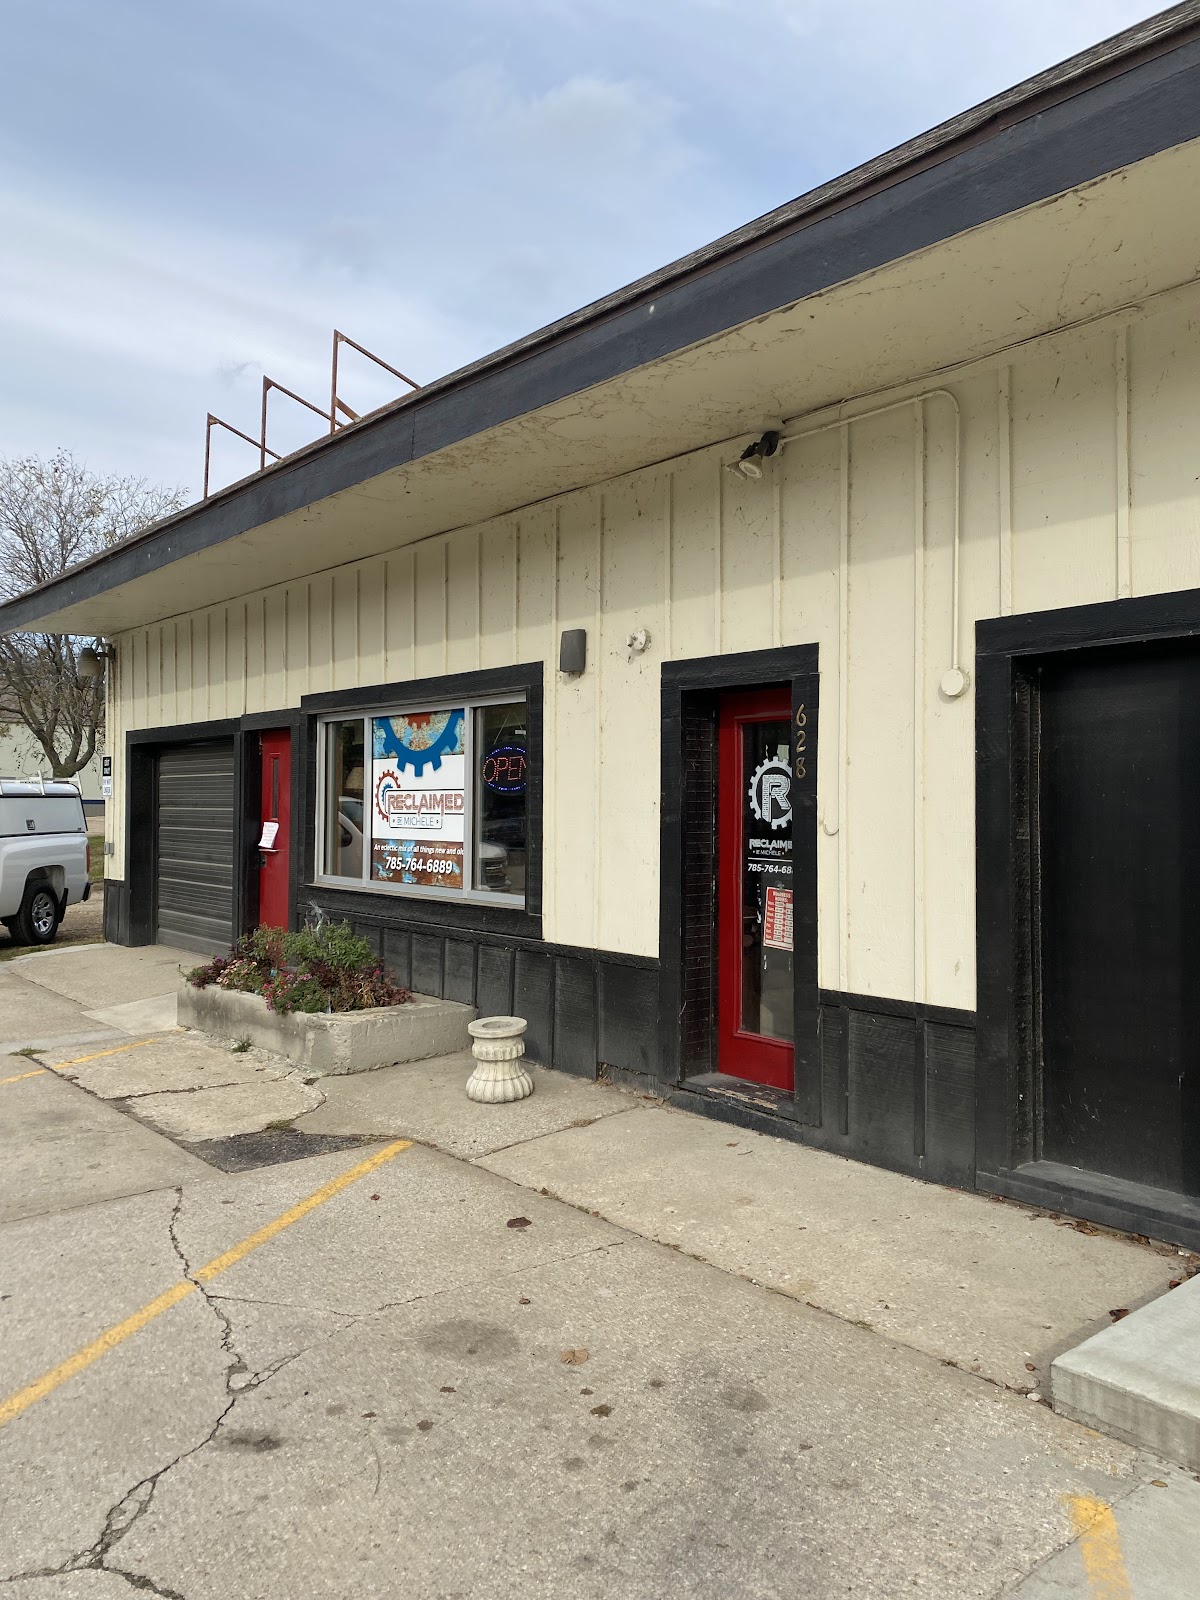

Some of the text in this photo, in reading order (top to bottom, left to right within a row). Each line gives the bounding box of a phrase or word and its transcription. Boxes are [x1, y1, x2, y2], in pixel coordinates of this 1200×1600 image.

[796, 703, 807, 779] 628
[388, 793, 464, 817] RECLAIMED
[762, 774, 791, 822] R
[404, 817, 434, 826] MICHELE
[373, 843, 381, 851] An
[381, 844, 398, 852] eclectic
[420, 845, 435, 855] things
[446, 847, 456, 855] and
[749, 838, 793, 852] RECLAIME
[385, 856, 453, 874] 785-764-6889
[748, 863, 794, 874] 785-764-68
